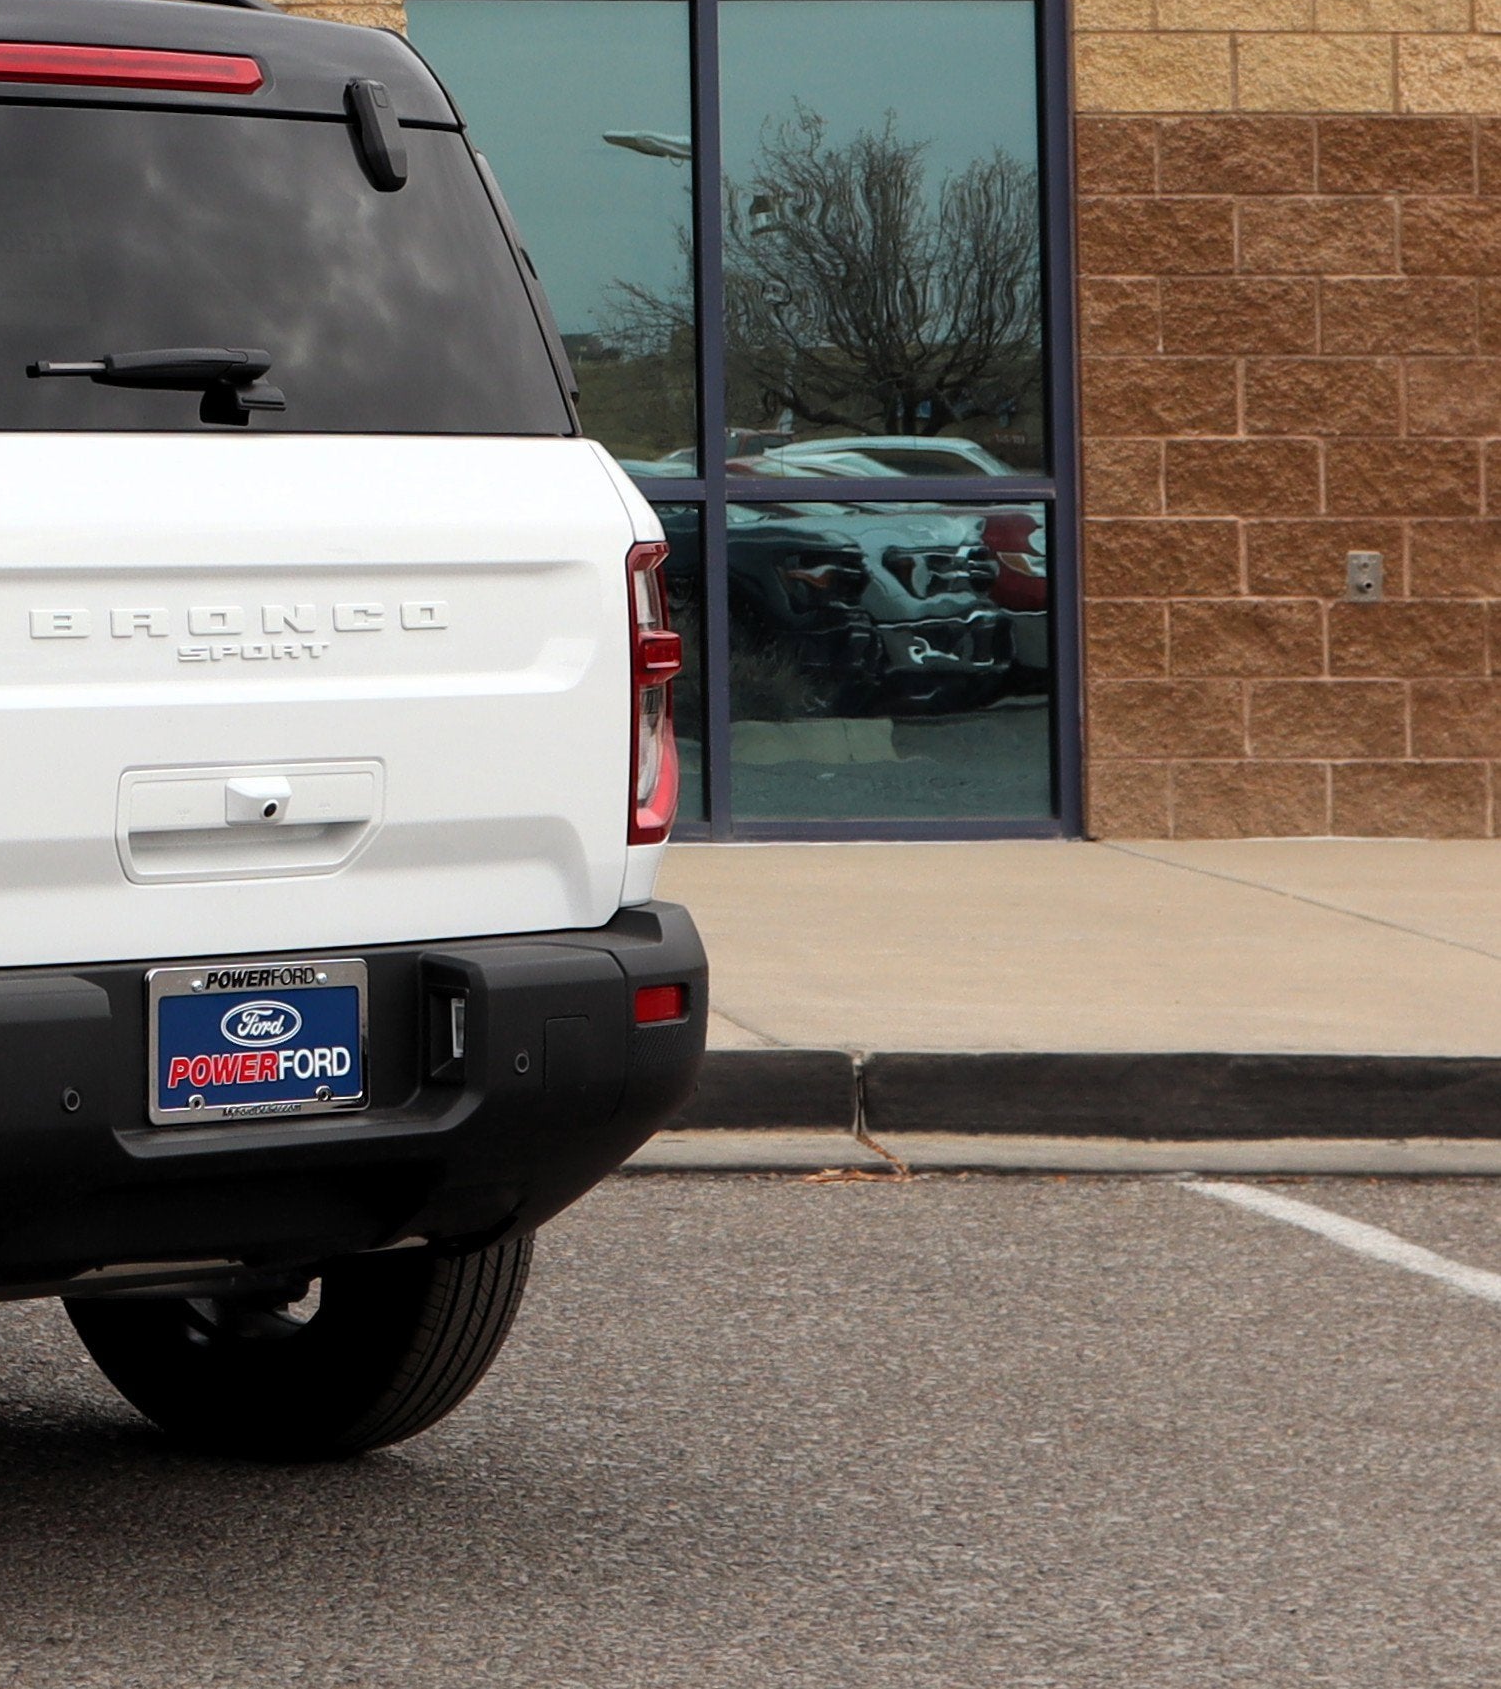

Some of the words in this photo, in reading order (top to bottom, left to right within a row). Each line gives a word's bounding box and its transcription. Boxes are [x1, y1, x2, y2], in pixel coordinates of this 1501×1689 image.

[29, 600, 449, 639] BRONCO
[177, 641, 331, 662] SPORT
[205, 967, 316, 990] POWERFORD
[237, 1009, 286, 1037] Ford
[167, 1046, 351, 1089] POWERFORD
